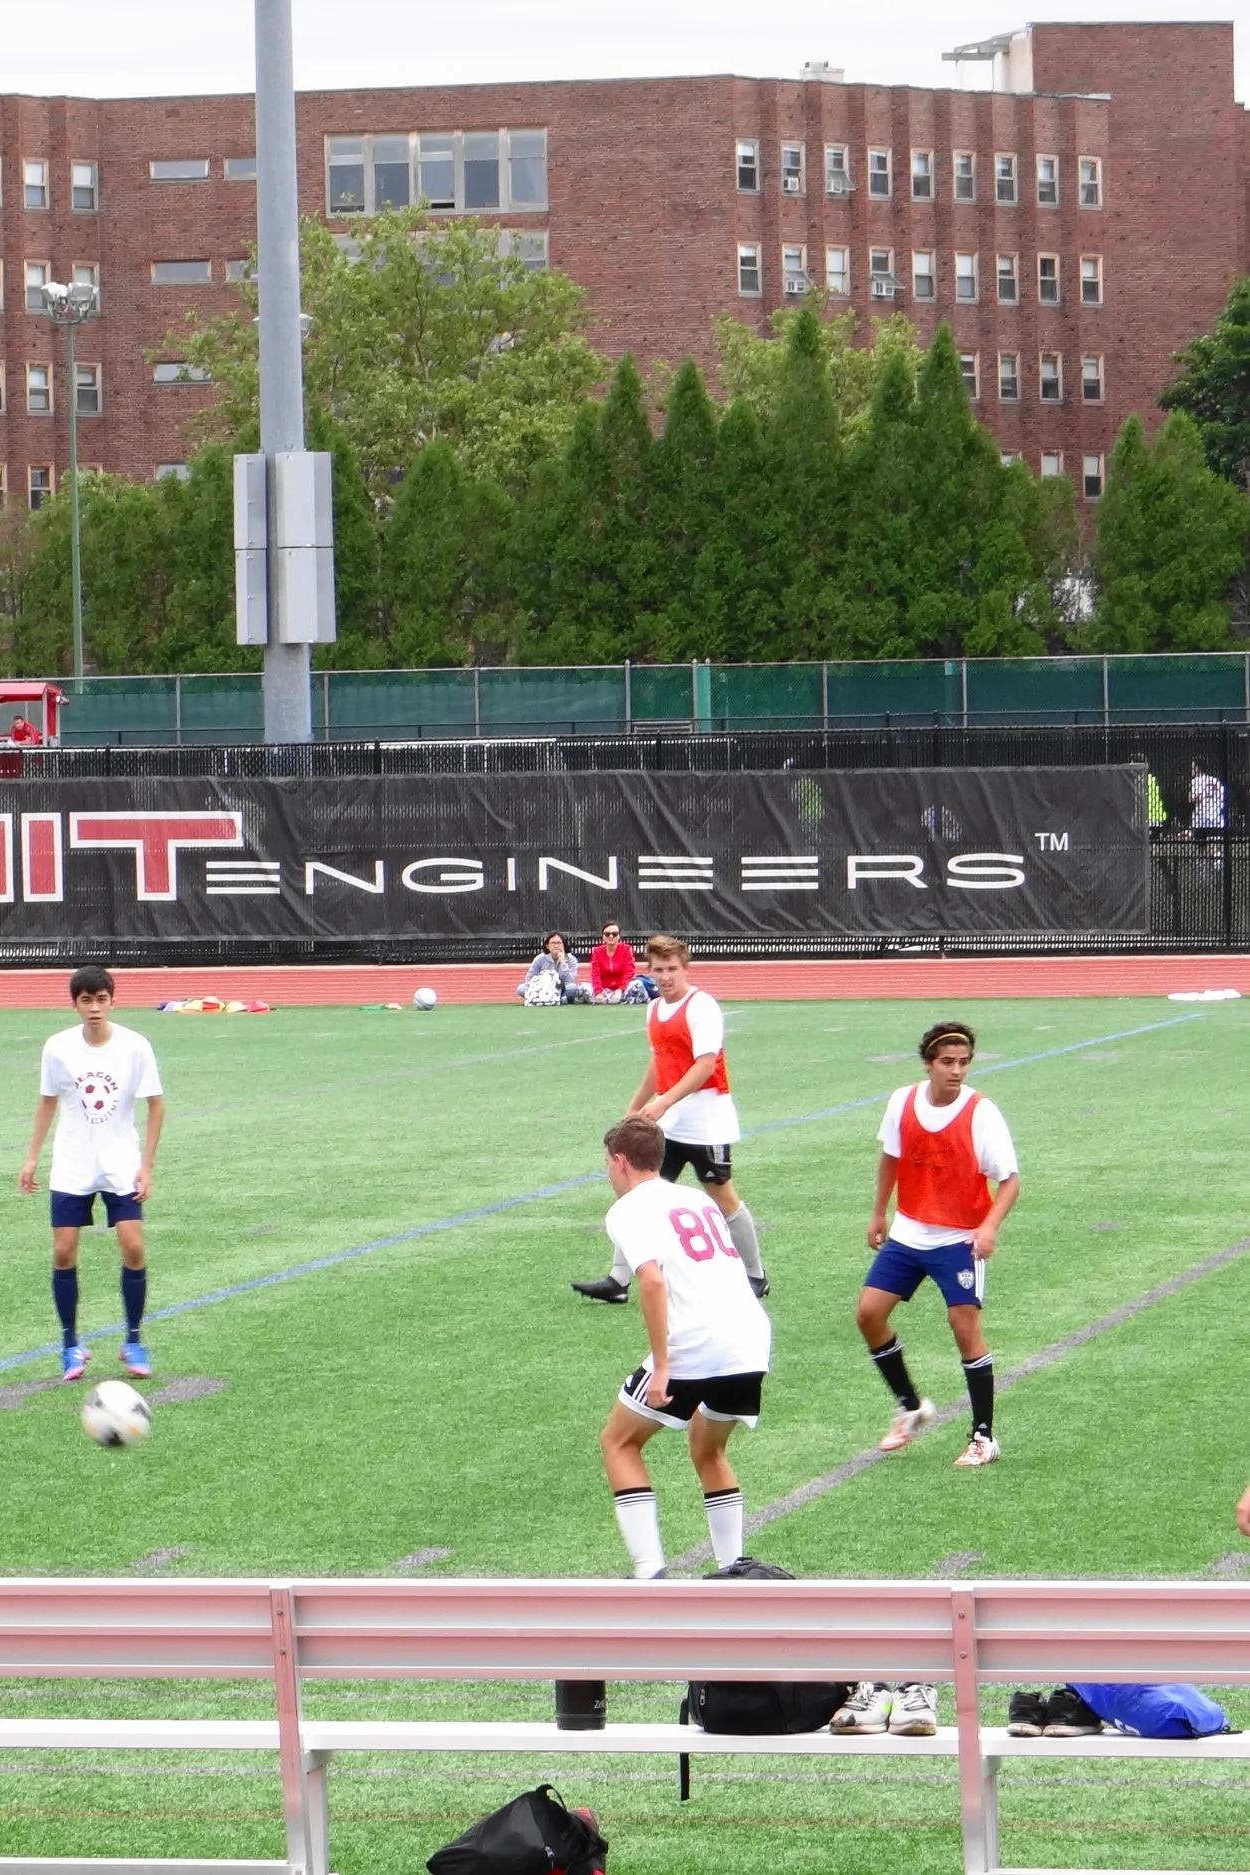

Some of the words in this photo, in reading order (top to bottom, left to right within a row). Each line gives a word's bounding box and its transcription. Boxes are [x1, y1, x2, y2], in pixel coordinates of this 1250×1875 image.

[205, 852, 1026, 894] ENGINEERS
[1034, 832, 1069, 851] TM
[668, 1206, 739, 1262] 80
